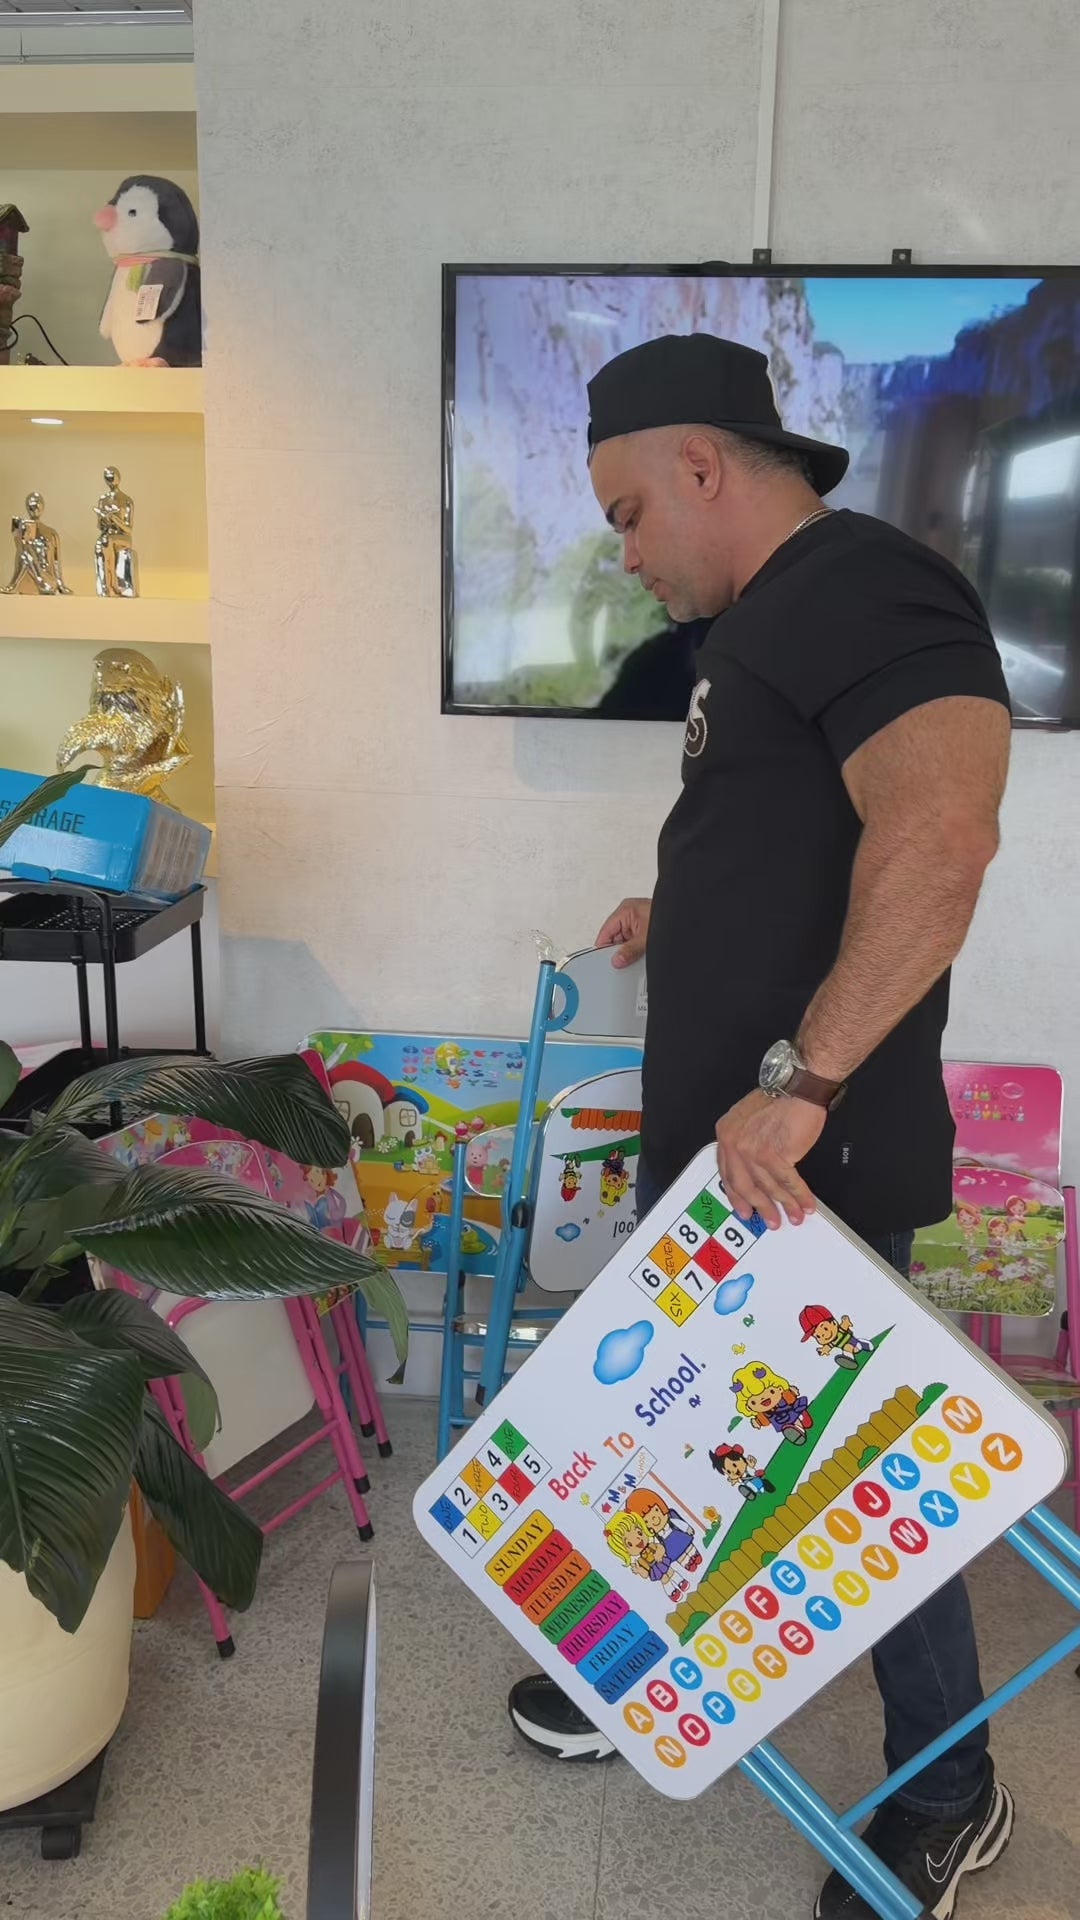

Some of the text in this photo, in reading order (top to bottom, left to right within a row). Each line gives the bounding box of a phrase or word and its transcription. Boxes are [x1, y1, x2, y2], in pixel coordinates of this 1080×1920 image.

[0, 799, 86, 834] SRAGE
[641, 1224, 699, 1288] 6 8
[662, 1195, 716, 1276] SEVEN NINE
[684, 1227, 744, 1291] 7 9
[670, 1291, 683, 1318] SIX
[548, 1353, 706, 1501] Back To School.
[440, 1499, 454, 1531] ONE
[503, 1427, 515, 1455] FIVE
[454, 1450, 503, 1506] 2 4
[462, 1454, 541, 1544] 1 3 5
[479, 1504, 490, 1534] TWO
[495, 1519, 544, 1577] SUNDAY
[511, 1538, 565, 1598] MONDAY
[527, 1558, 584, 1616] TUESDAY
[629, 1398, 979, 1730] A B C D E F G H I J K L M
[545, 1577, 605, 1638] WEDNESDAY
[563, 1596, 623, 1658] THURSDAY
[657, 1438, 1017, 1763] N O P Q R S T U V W X Y Z
[589, 1624, 635, 1672] FRIDAY
[600, 1639, 661, 1700] SATURDAY
